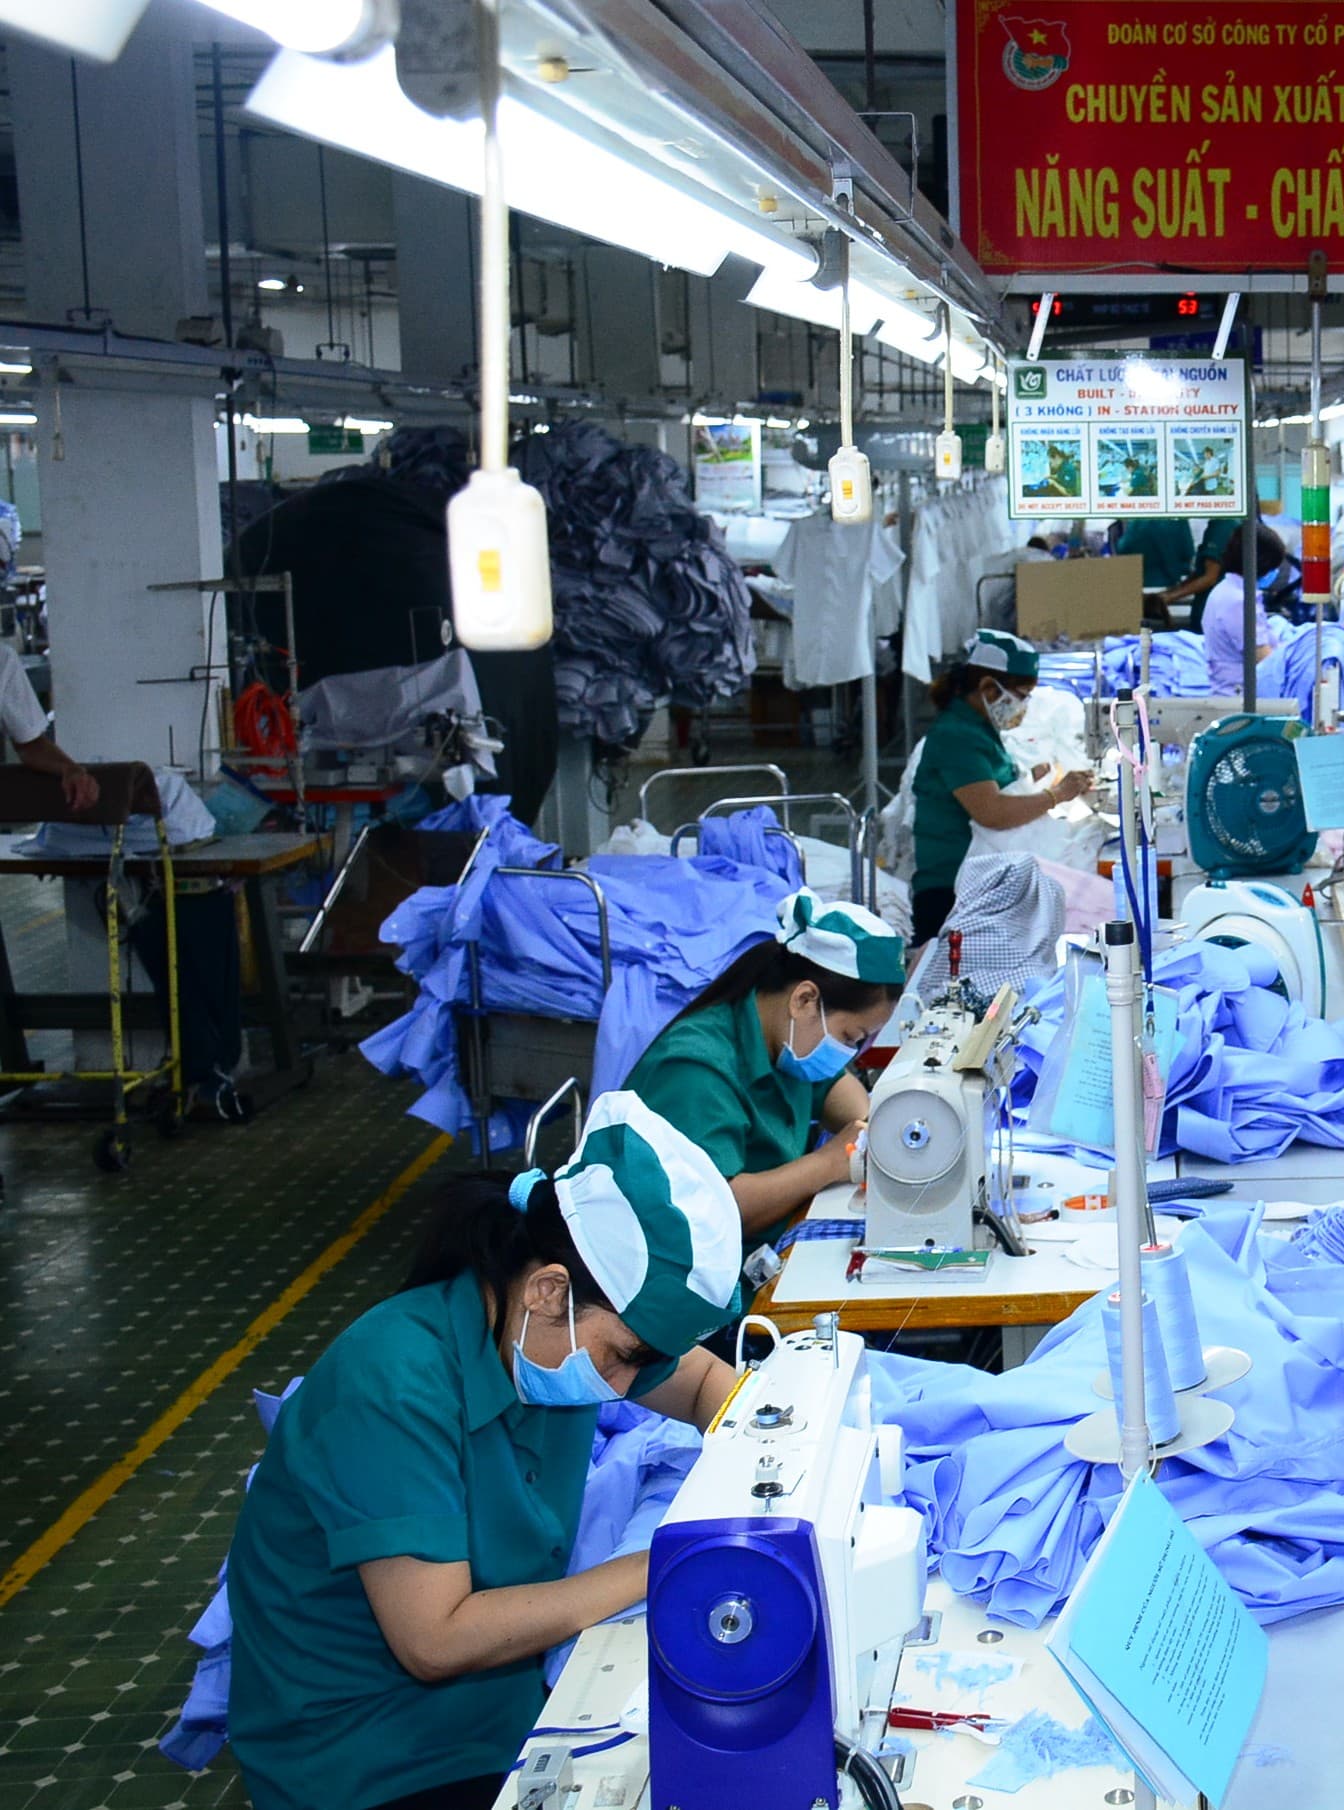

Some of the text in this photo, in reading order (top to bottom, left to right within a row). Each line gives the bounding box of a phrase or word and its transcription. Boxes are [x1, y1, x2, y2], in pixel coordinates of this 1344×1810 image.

[1108, 20, 1156, 45] ĐOÀN
[1163, 22, 1189, 45] CƠ
[1192, 17, 1217, 45] SỞ
[1222, 19, 1270, 46] CÔNG
[1275, 25, 1298, 45] TY
[1304, 13, 1329, 46] CỔ
[1065, 68, 1191, 124] CHUYỀN
[1201, 70, 1263, 124] SẢN
[1015, 153, 1119, 239] NĂNG
[1132, 139, 1231, 239] SUẤT
[1178, 300, 1199, 316] 53
[1056, 363, 1093, 382] CHẤT
[1077, 388, 1115, 399] BUILT
[1025, 406, 1032, 416] 3
[1038, 404, 1083, 416] KHÔNG
[1097, 405, 1110, 415] IN
[1124, 405, 1179, 416] STATION
[1184, 404, 1239, 416] QUALITY
